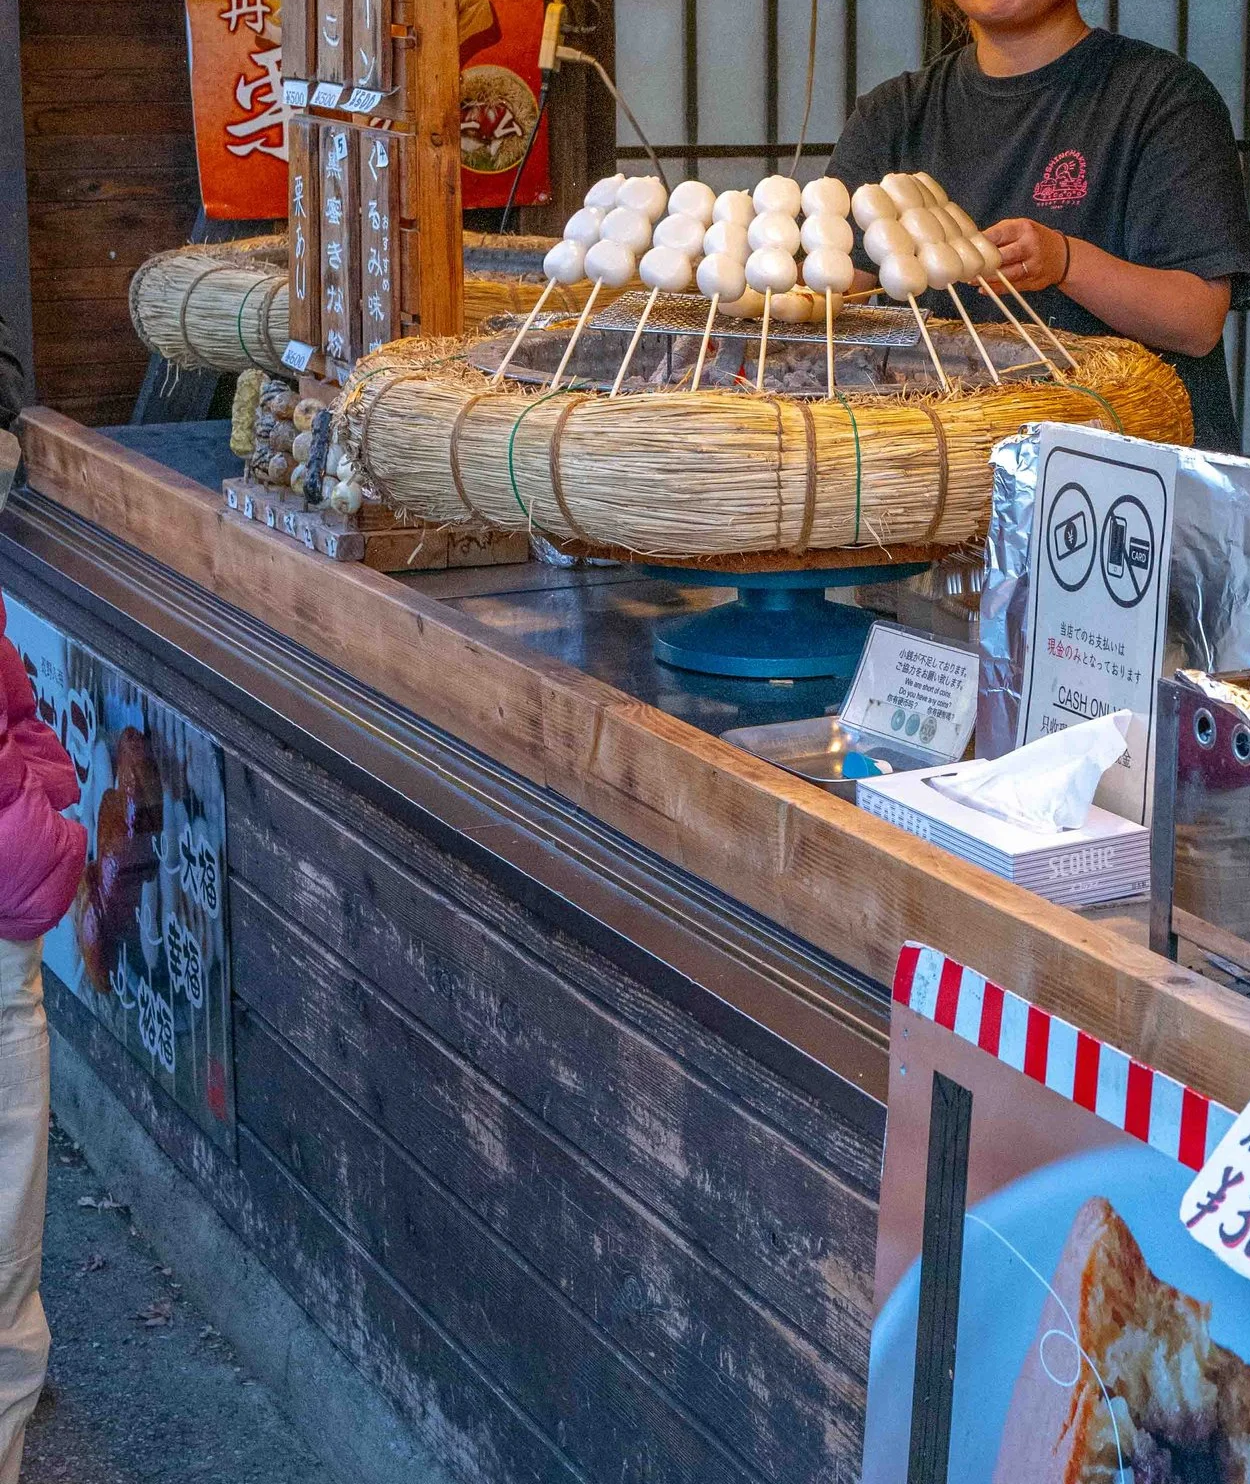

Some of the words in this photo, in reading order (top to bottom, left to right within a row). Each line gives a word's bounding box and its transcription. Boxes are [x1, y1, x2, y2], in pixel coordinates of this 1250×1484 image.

[1131, 549, 1147, 563] CARD
[1060, 621, 1125, 656] 当店でのお支払いは
[1047, 636, 1142, 685] 現金のみとなっております
[1058, 685, 1088, 714] CASH
